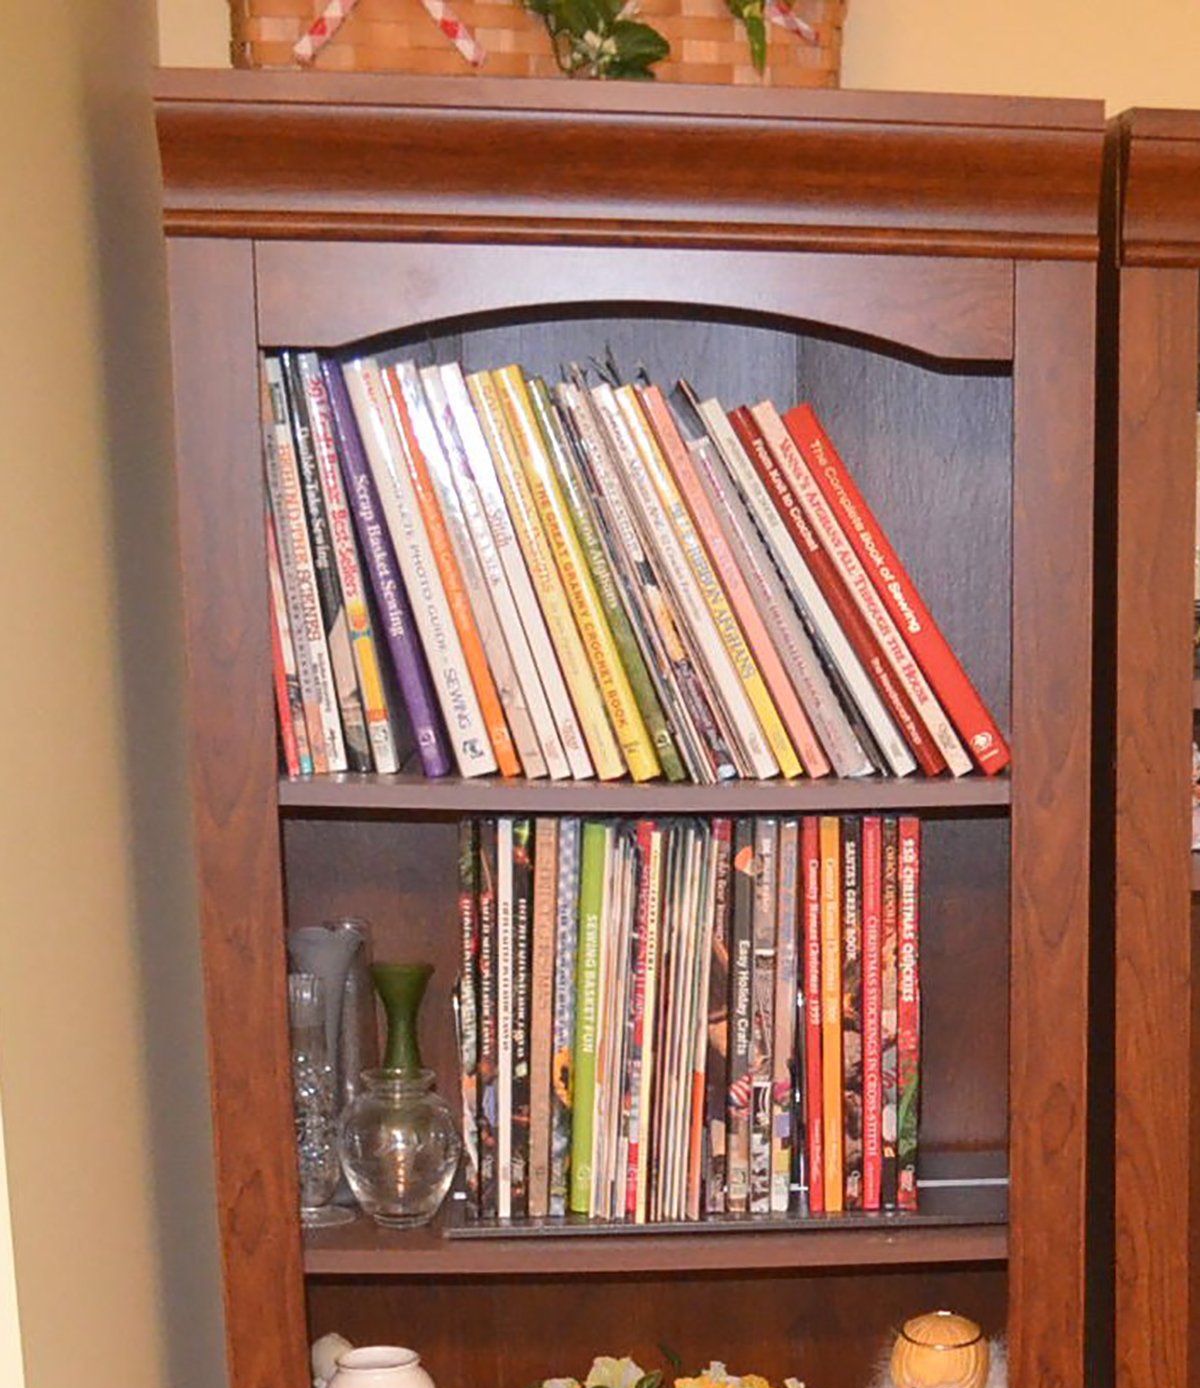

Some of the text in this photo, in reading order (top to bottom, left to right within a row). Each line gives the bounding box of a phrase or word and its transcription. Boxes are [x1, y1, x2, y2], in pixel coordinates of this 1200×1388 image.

[750, 437, 820, 552] From Knit to Crochet
[330, 507, 362, 597] Best-Sellers
[351, 473, 407, 637] Scrap Basket Sewing
[587, 546, 621, 610] Afghans
[808, 439, 923, 635] The Complete Book of Sewing
[296, 567, 321, 641] SCENES
[407, 543, 432, 600] PHOTO
[442, 666, 472, 729] SEWING
[534, 481, 550, 506] THE
[545, 510, 568, 557] GREAT
[562, 560, 590, 618] GRANNY
[583, 621, 613, 685] CROCHET
[606, 688, 628, 728] BOOK
[805, 488, 845, 549] AFGHANS
[837, 546, 860, 575] ALL
[851, 572, 893, 636] THROUGH
[886, 634, 907, 661] THE
[900, 661, 931, 704] HOUSE
[713, 606, 757, 680] AFGHANS
[846, 928, 855, 960] BOOK
[902, 867, 914, 939] CHRISTMAS
[581, 913, 597, 1052] SEWING BASKET FUN
[809, 942, 819, 993] Christmas
[867, 915, 876, 984] CHRISTMAS
[735, 940, 749, 1054] Easy Holiday Crafts
[867, 987, 876, 1056] STOCKINGS
[867, 1058, 876, 1072] IN
[867, 1073, 877, 1155] CROSS-STITCH
